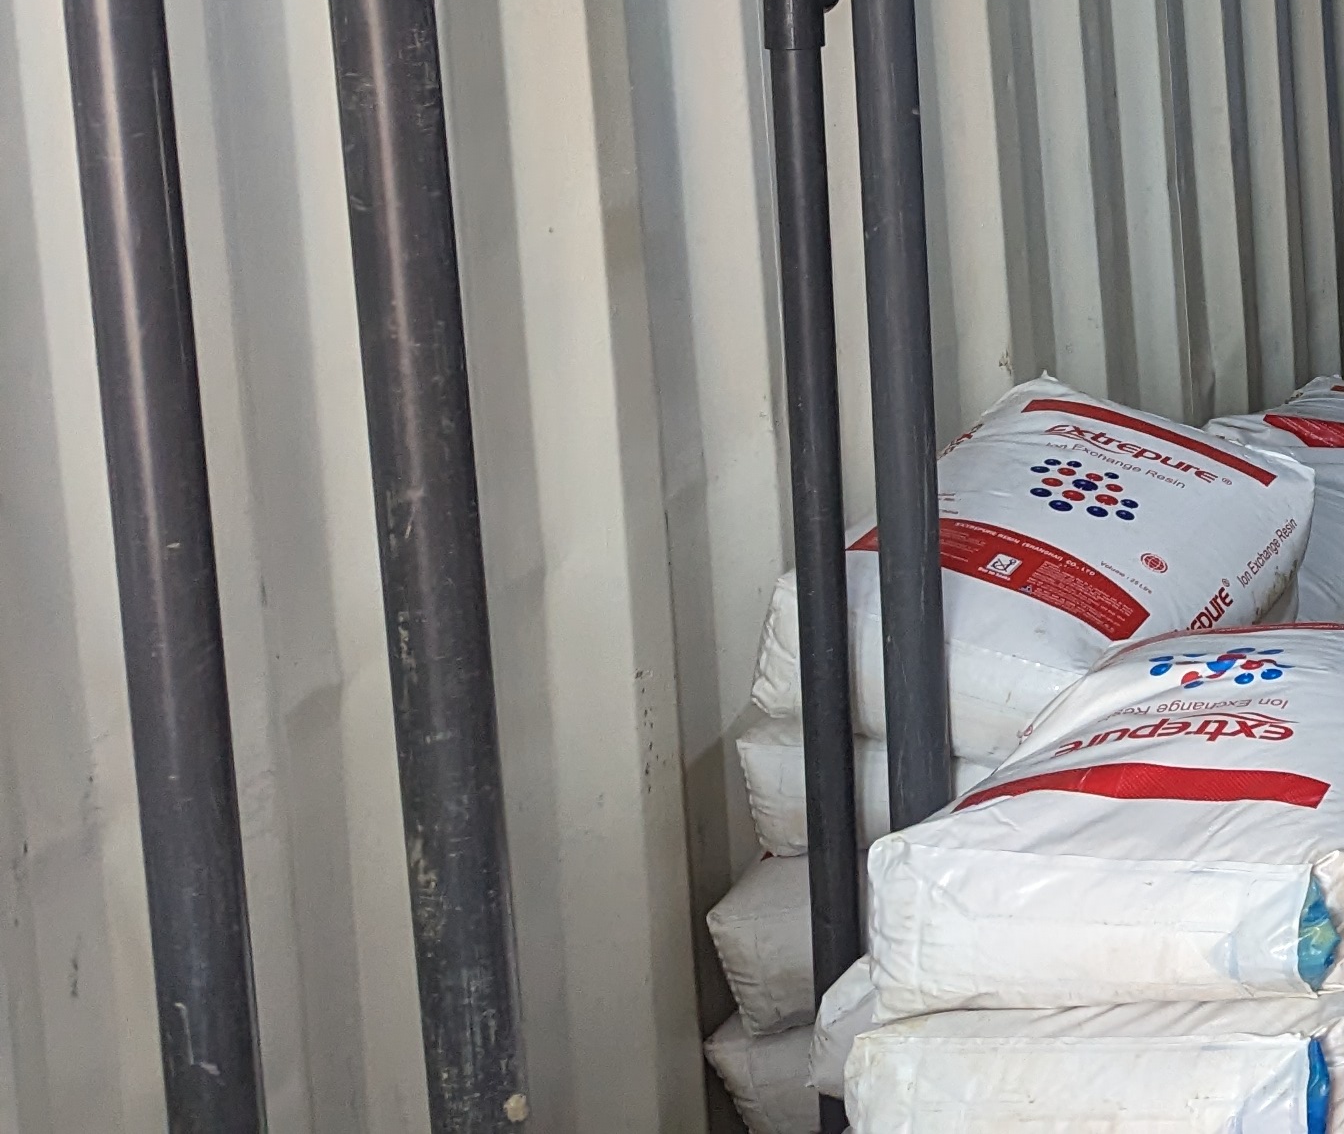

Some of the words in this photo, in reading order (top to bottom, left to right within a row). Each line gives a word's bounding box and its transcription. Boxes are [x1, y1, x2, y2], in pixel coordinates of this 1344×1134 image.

[1072, 443, 1142, 472] Exchange
[1146, 468, 1186, 490] Resin
[1237, 572, 1252, 588] Ion
[1247, 536, 1281, 576] Exchange
[1276, 518, 1297, 544] Resin
[1156, 698, 1252, 713] Exchange
[1267, 698, 1288, 709] Ion
